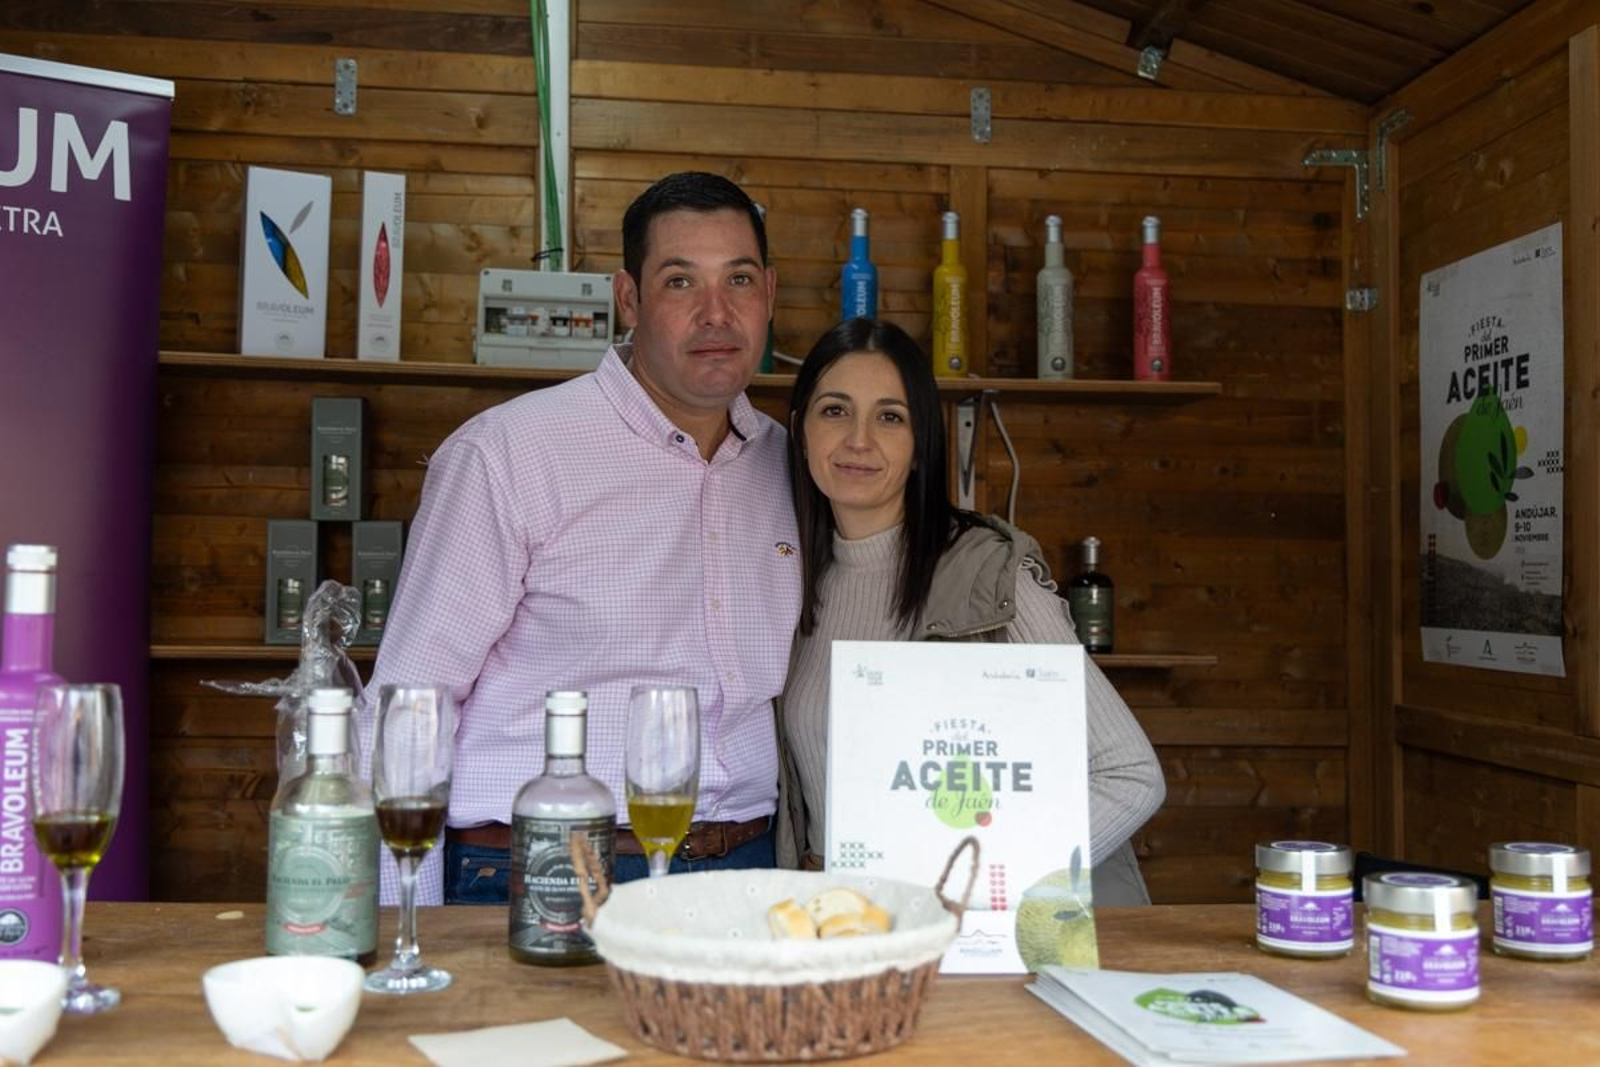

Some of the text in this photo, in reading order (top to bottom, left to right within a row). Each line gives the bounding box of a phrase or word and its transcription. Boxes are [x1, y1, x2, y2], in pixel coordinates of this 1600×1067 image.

[0, 206, 63, 237] TRA
[950, 282, 961, 342] BRAVOLEUM
[1152, 287, 1162, 346] BRAVOLEUM
[1464, 335, 1509, 363] PRIMER
[1446, 353, 1530, 405] ACEITE
[934, 718, 986, 733] FIESTA
[922, 739, 998, 757] PRIMER
[890, 760, 1033, 792] ACEITE
[0, 727, 29, 874] BRAVOLEUM
[524, 874, 569, 886] HACIENDA
